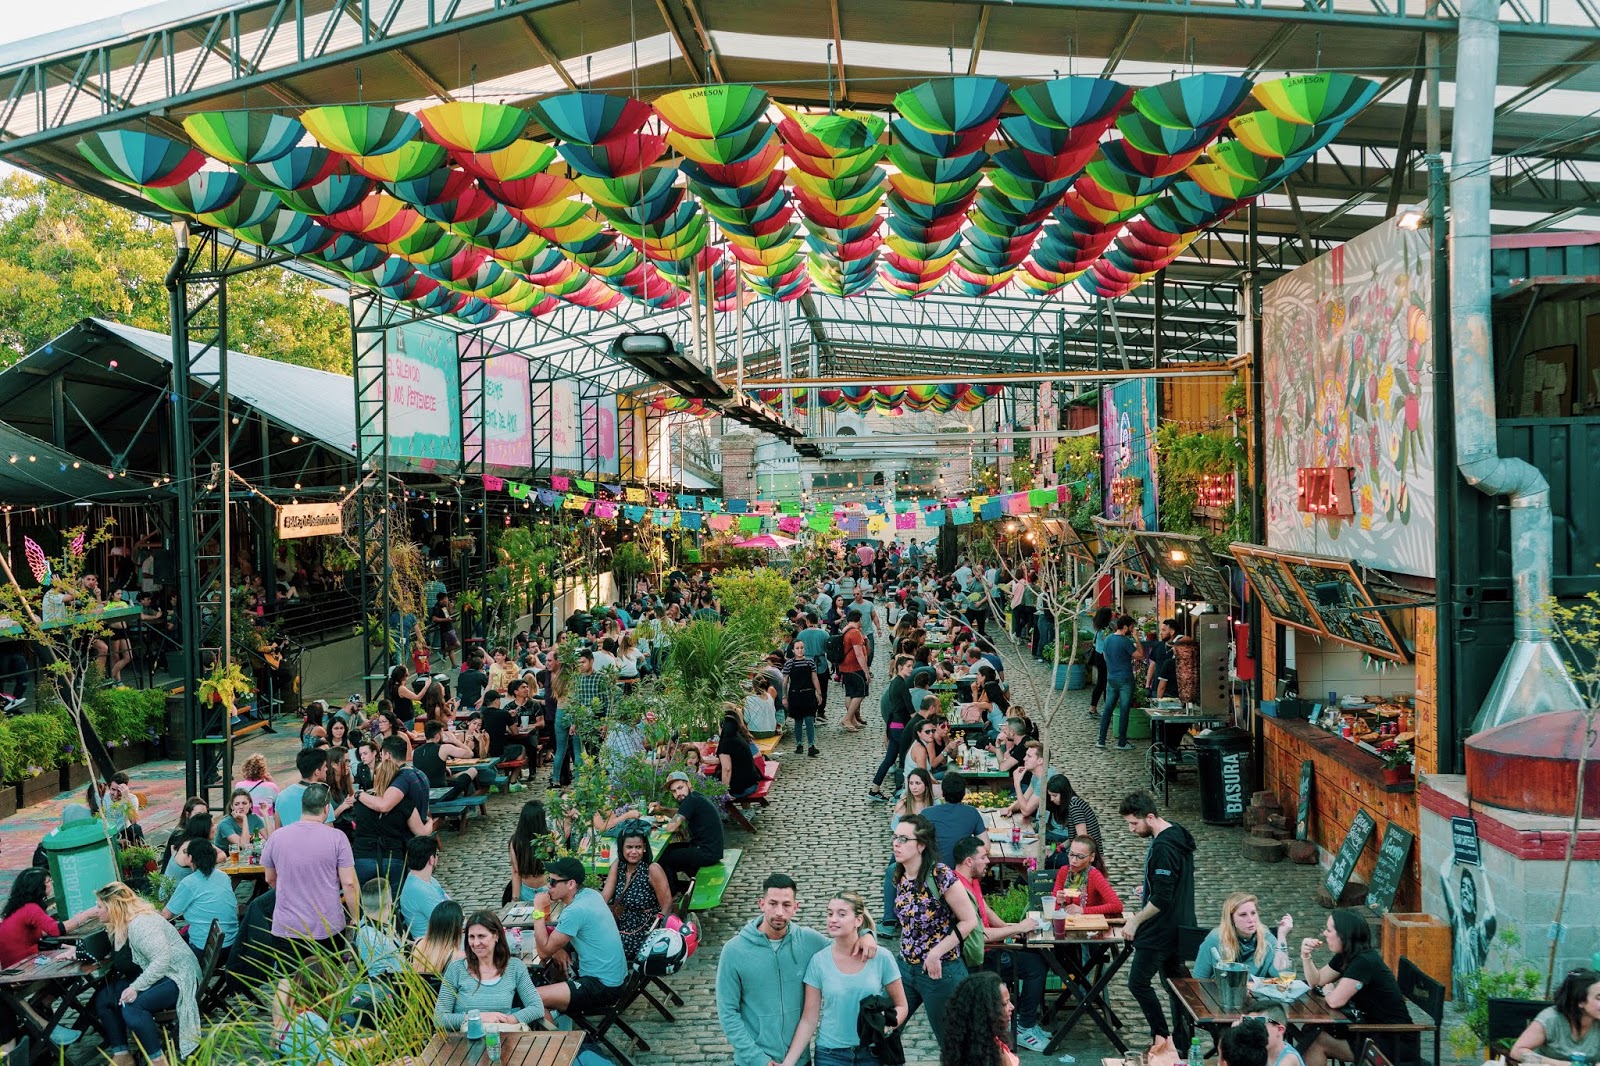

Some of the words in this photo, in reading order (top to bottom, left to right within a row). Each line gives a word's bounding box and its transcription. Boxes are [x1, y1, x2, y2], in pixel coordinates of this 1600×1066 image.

[688, 89, 724, 99] JAMESON
[1287, 76, 1325, 87] JAMESON
[387, 358, 394, 376] EL
[395, 358, 420, 383] SILENCIO
[407, 385, 437, 411] PERTENECE
[1222, 753, 1243, 813] BASURA
